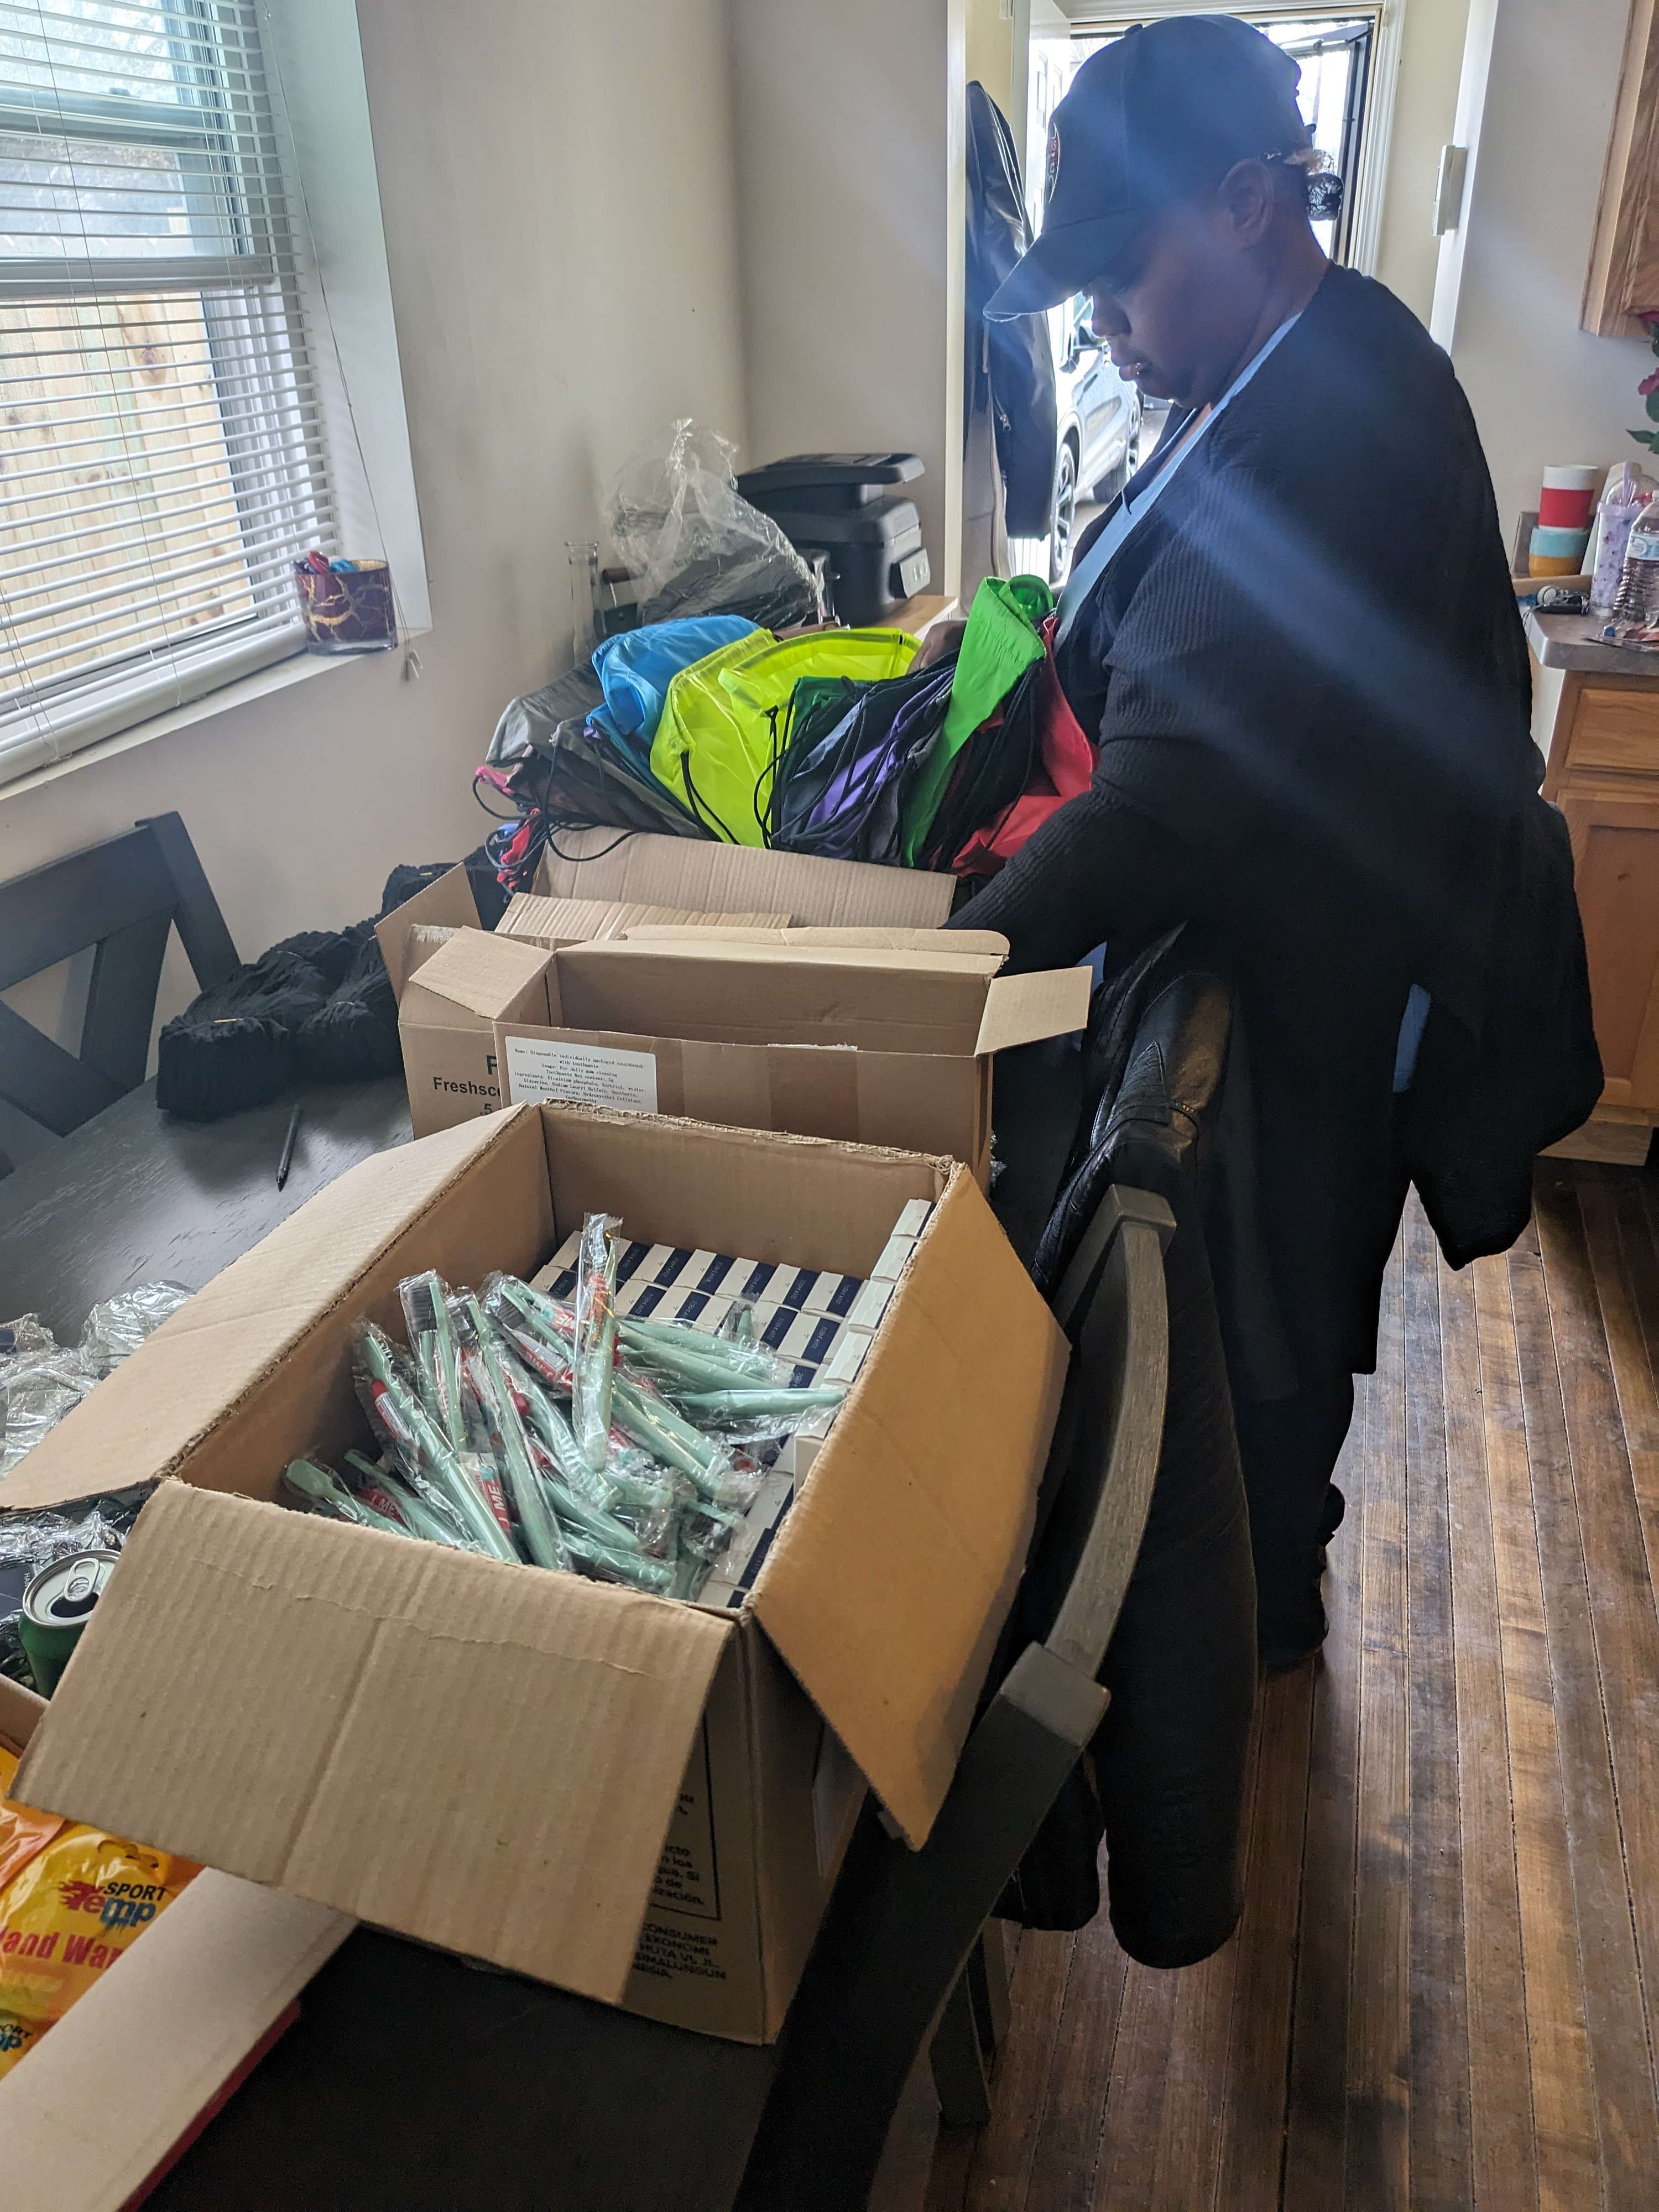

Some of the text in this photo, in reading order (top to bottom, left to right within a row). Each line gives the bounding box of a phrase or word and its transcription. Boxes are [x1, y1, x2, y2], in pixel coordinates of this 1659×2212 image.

[559, 1053, 589, 1062] individually
[433, 1077, 501, 1098] Freshsc
[103, 1881, 168, 1901] SPORT
